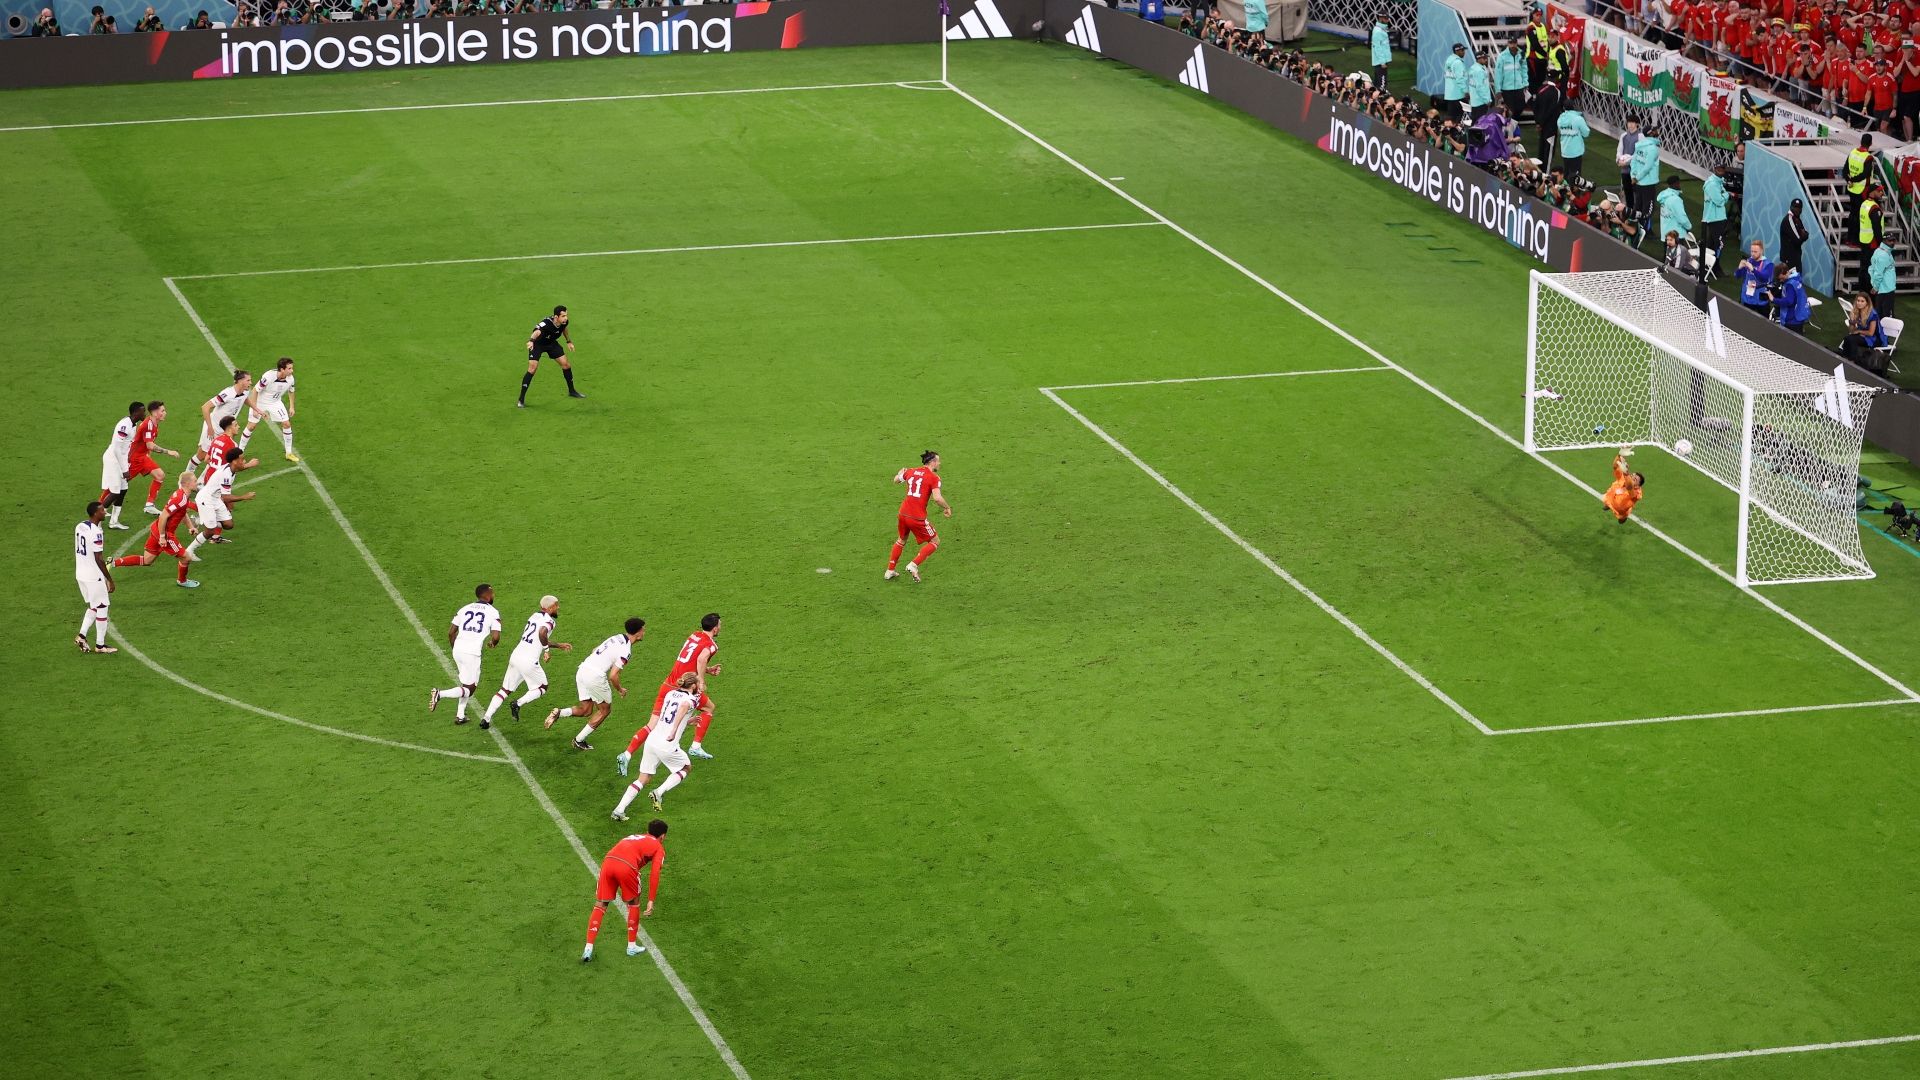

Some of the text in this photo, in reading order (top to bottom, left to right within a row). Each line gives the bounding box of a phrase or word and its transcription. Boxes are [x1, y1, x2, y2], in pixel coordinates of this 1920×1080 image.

[221, 11, 732, 74] impossible is nothing
[1330, 106, 1550, 263] impossible is nothing
[210, 447, 223, 469] 15
[907, 476, 923, 498] 11
[76, 532, 87, 556] 19
[462, 610, 485, 634] 23
[677, 639, 698, 664] 13
[660, 700, 679, 725] 13
